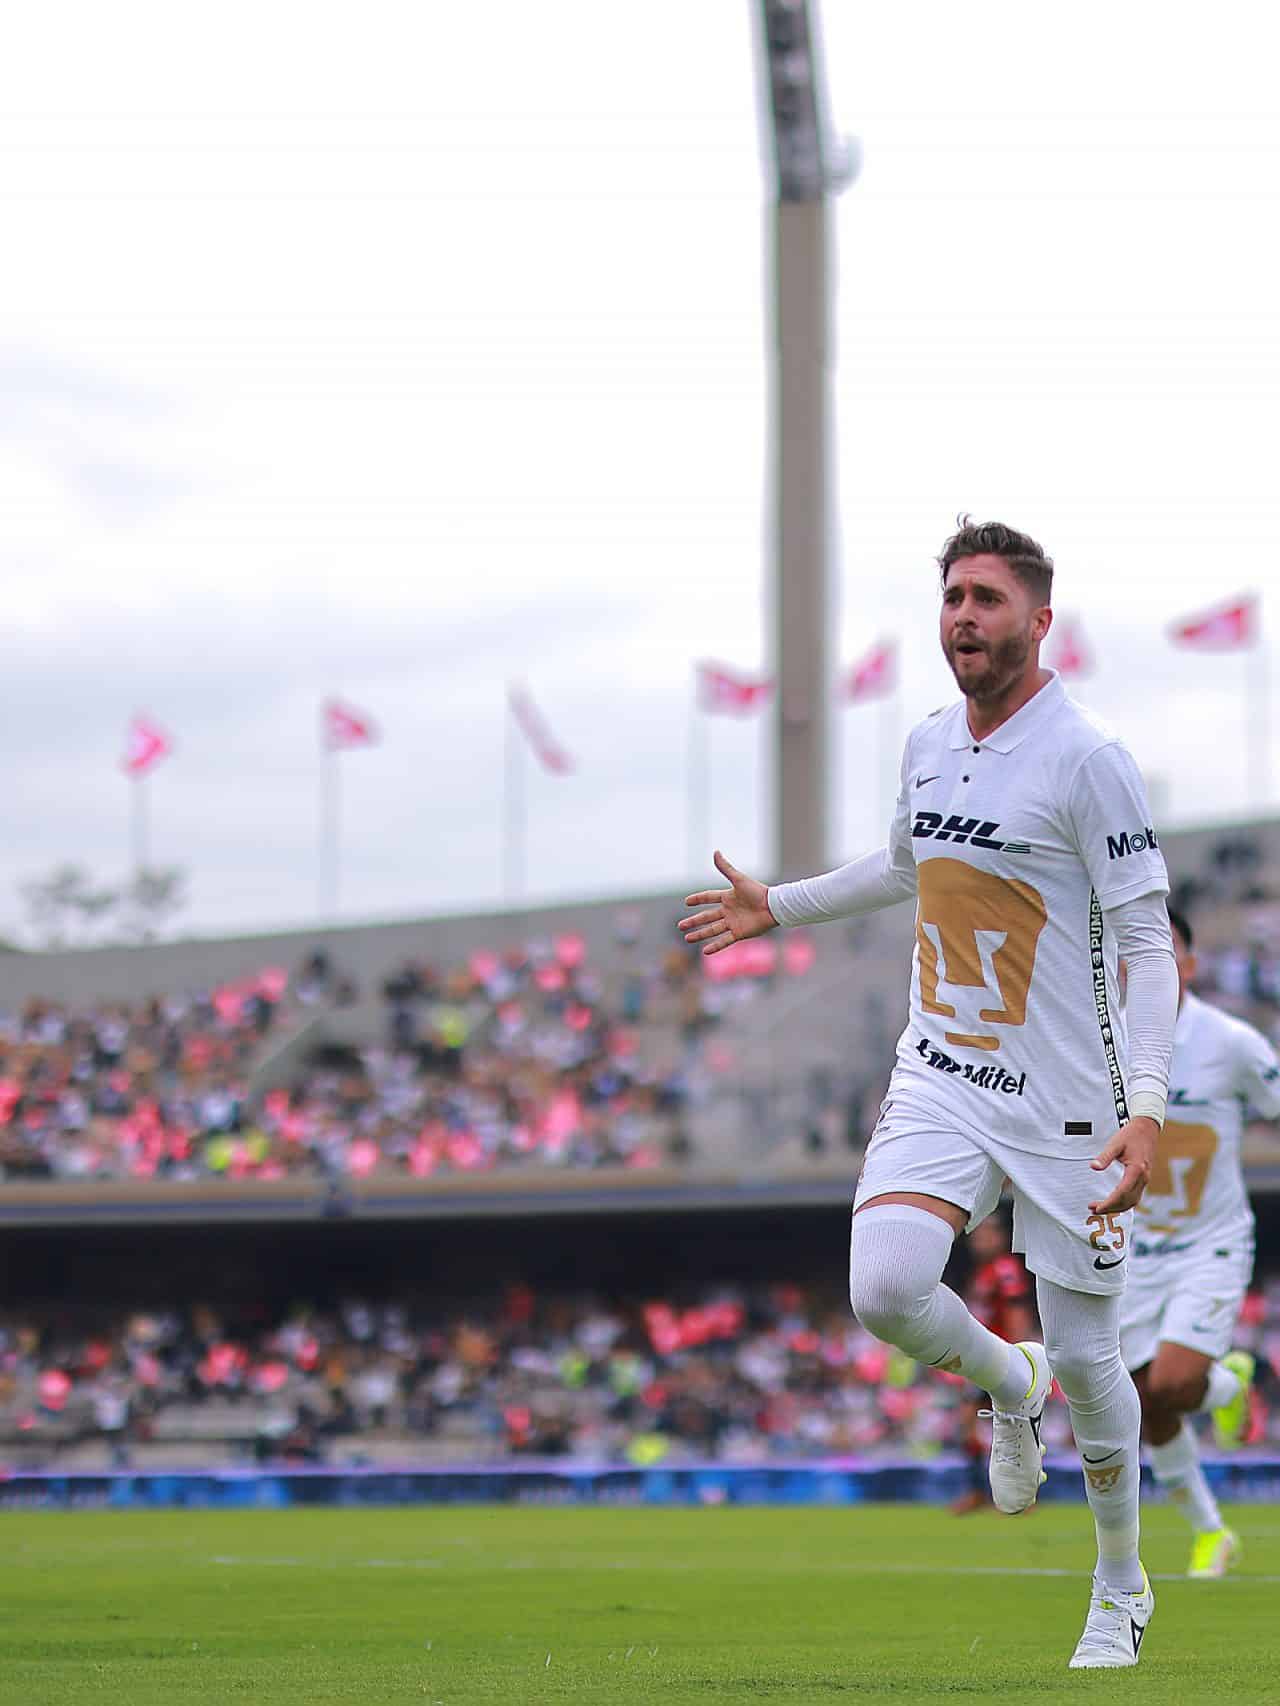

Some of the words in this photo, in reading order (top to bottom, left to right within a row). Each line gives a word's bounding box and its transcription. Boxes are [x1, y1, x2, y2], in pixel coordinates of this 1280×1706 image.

[911, 811, 1007, 851] DHL
[1094, 967, 1109, 1026] PUMAS
[961, 1063, 1026, 1097] Mifel
[1105, 1043, 1124, 1101] PUMAS
[1086, 1212, 1125, 1252] 25
